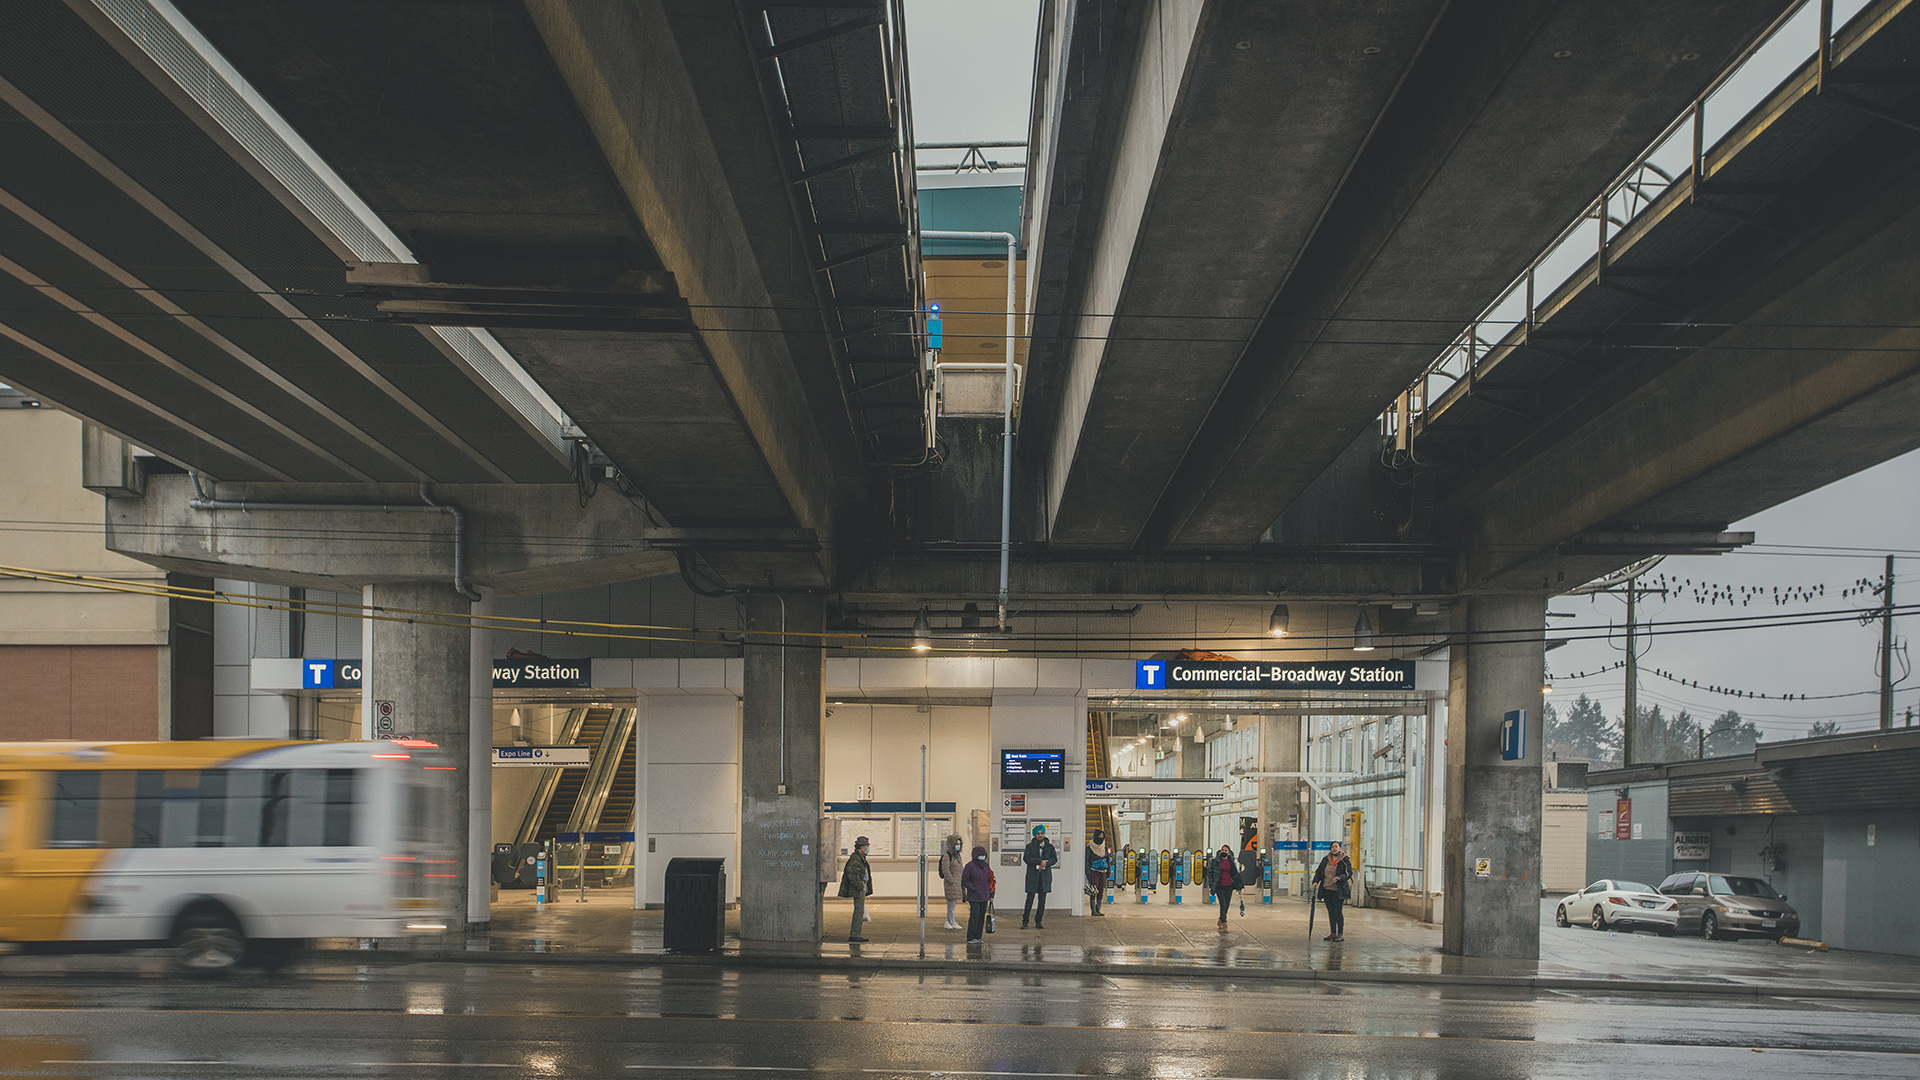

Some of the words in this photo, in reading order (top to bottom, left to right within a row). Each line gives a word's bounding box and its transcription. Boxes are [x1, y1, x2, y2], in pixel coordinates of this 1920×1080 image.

[309, 664, 327, 684] T
[524, 664, 580, 680] Station
[1142, 665, 1160, 685] T
[1349, 666, 1404, 682] Station
[500, 750, 516, 758] Expo
[1674, 835, 1710, 845] ALBERTO
[779, 849, 796, 858] OFF
[764, 859, 778, 867] THE
